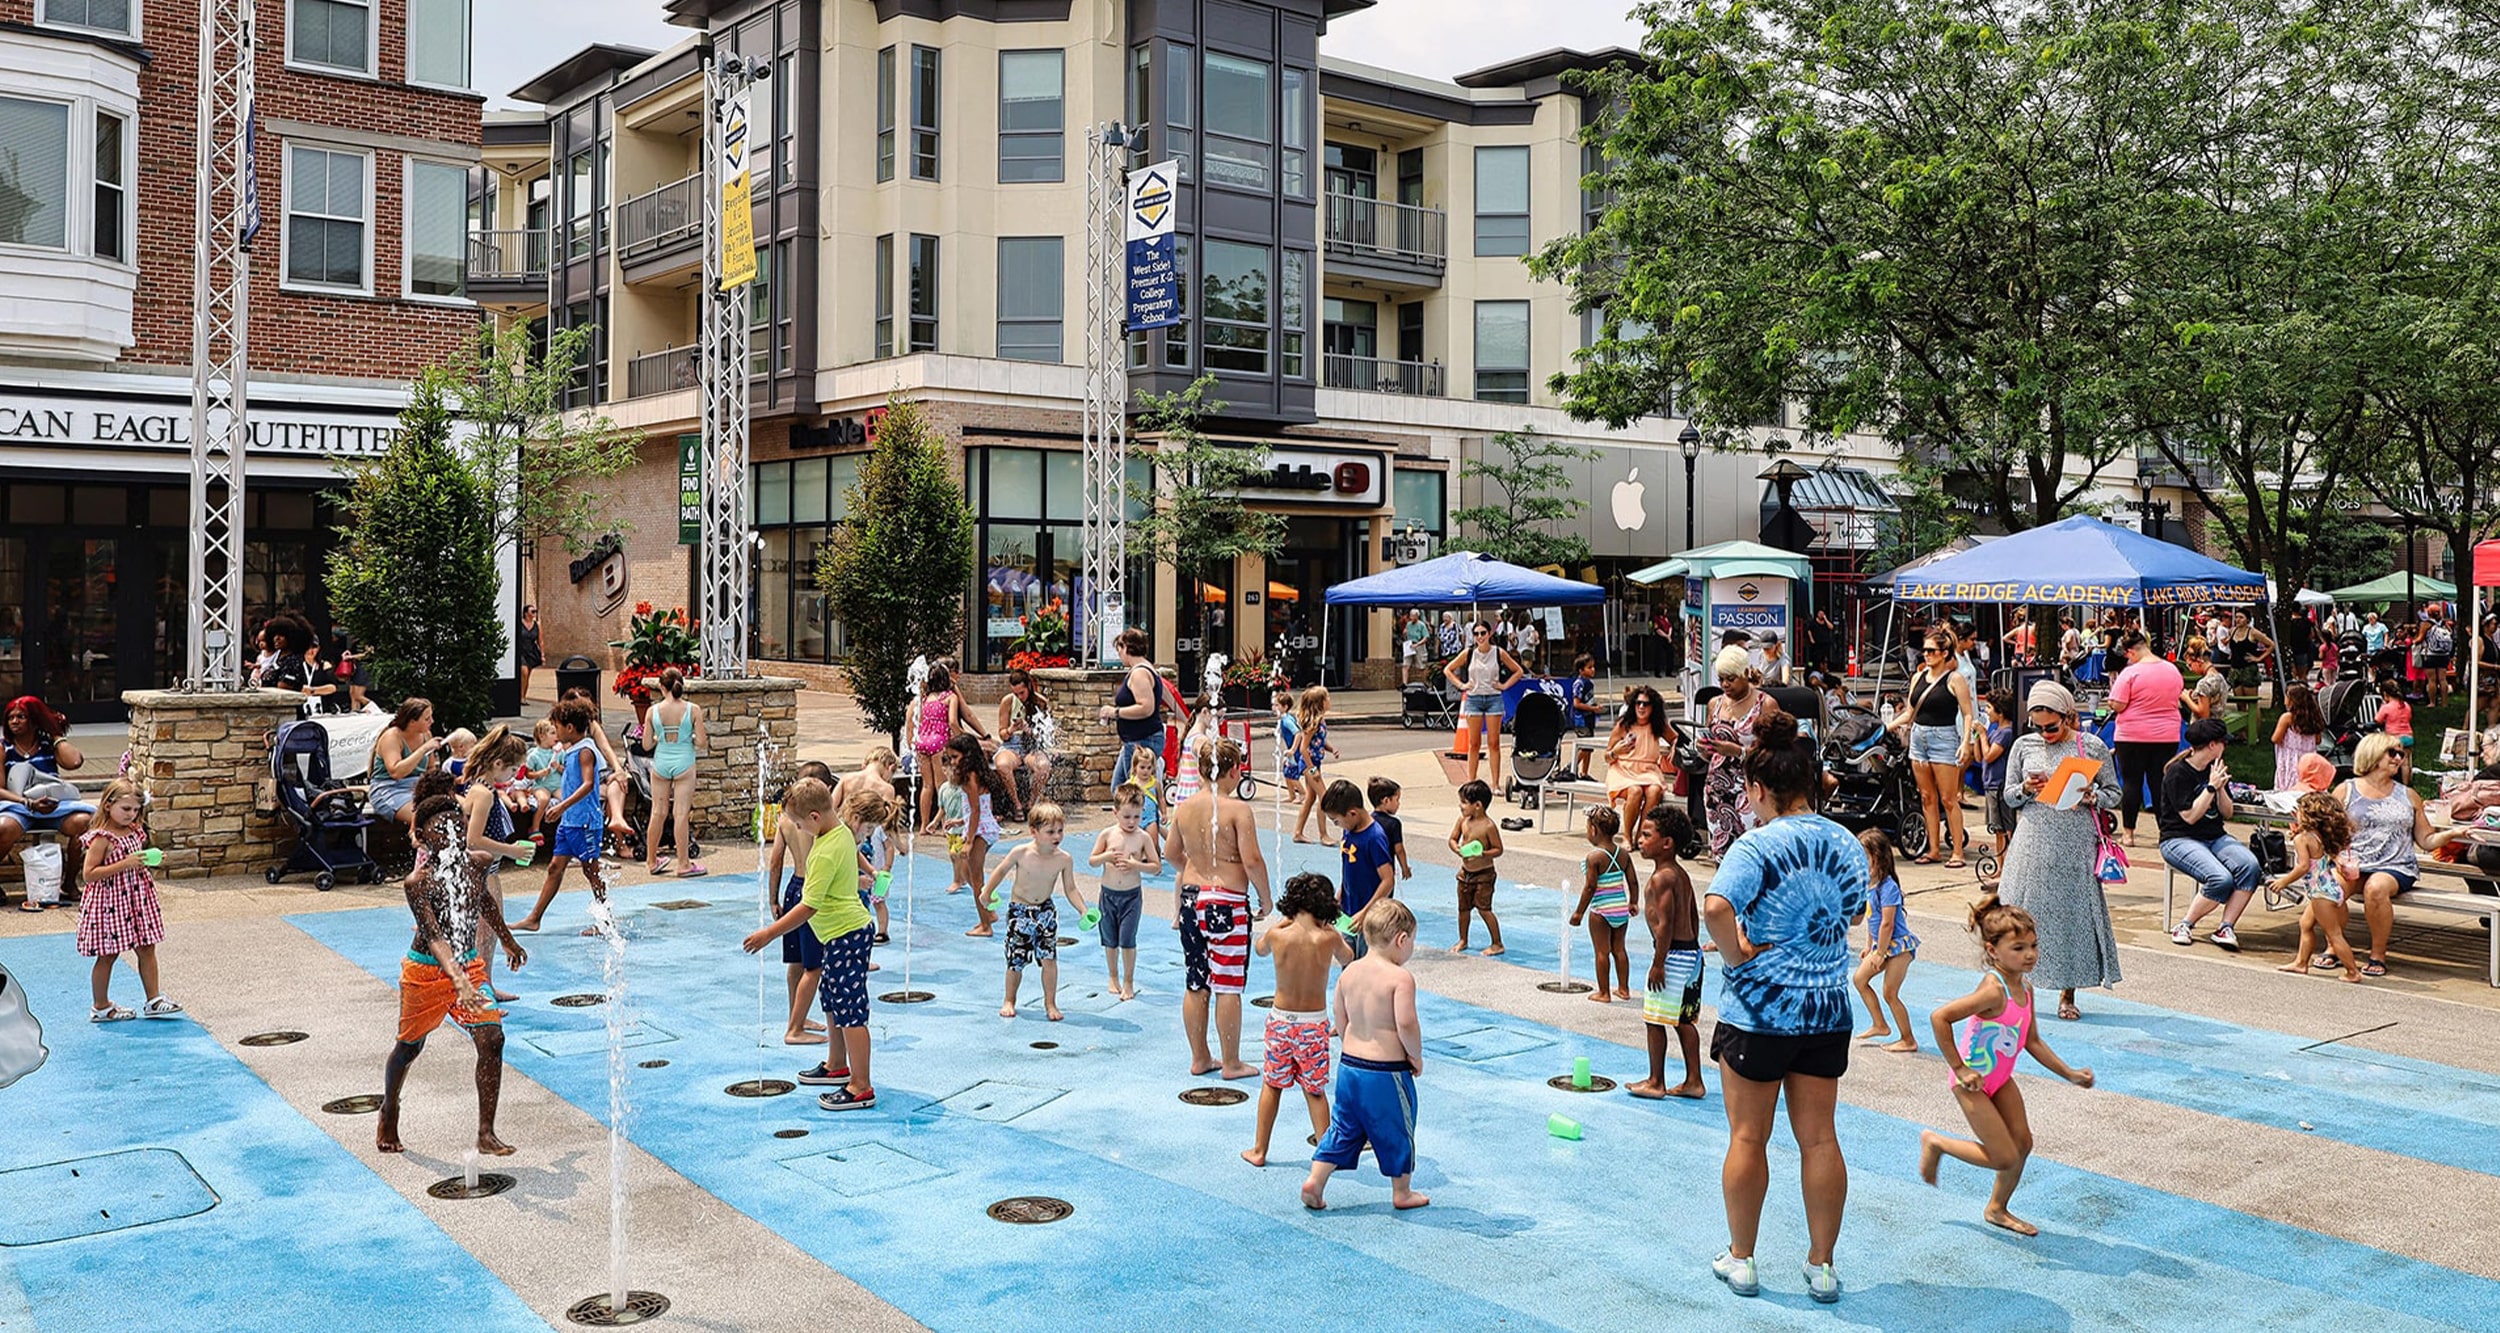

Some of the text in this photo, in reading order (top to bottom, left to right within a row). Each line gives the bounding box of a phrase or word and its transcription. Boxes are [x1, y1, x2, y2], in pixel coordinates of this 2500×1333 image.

[1146, 250, 1160, 261] The
[1133, 264, 1151, 276] West
[1131, 276, 1159, 289] Premier
[1140, 287, 1166, 299] College
[1133, 299, 1173, 314] Preparatory
[1142, 311, 1166, 325] School
[93, 413, 211, 444] EAGL
[681, 477, 699, 491] FIND
[681, 492, 700, 506] YOUR
[681, 507, 700, 520] PATH
[1902, 583, 2134, 605] LAKE RIDGE ACADEMY
[2144, 585, 2267, 605] LAKE RIDGE ACADEMY
[1718, 612, 1778, 625] PASSION
